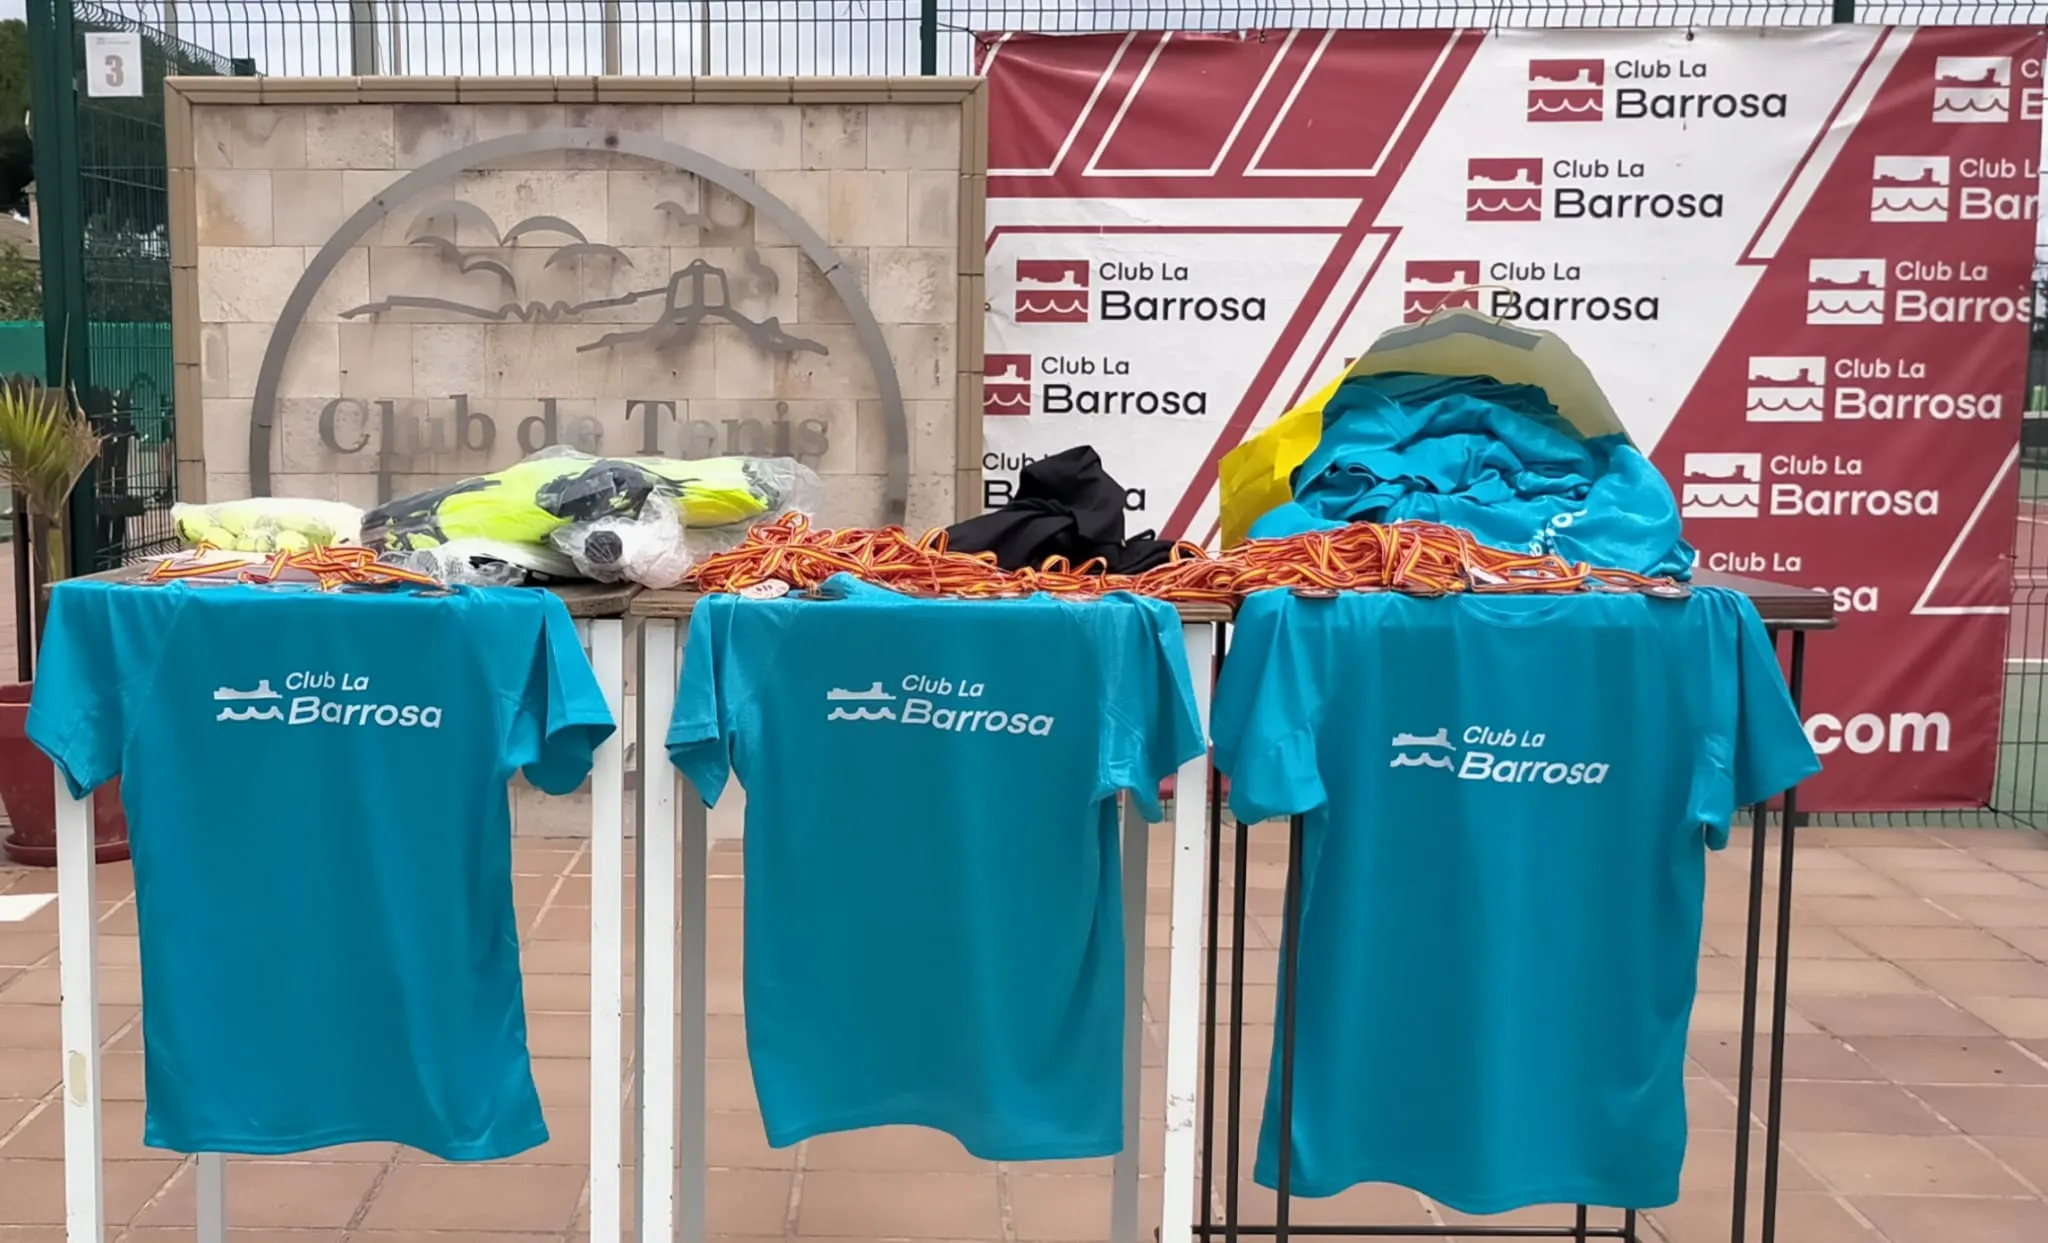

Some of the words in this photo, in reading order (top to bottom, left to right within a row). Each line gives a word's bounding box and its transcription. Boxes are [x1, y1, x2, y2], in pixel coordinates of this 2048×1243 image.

[105, 55, 124, 87] 3
[1615, 60, 1671, 78] Club
[1679, 60, 1707, 78] La
[1616, 89, 1787, 118] Barrosa
[1554, 160, 1609, 178] Club
[1617, 160, 1645, 178] La
[1960, 158, 2016, 178] Club
[1555, 189, 1723, 218] Barrosa
[1100, 262, 1153, 281] Club
[1162, 263, 1188, 281] La
[1491, 262, 1545, 281] Club
[1554, 263, 1580, 281] La
[1895, 261, 1952, 280] Club
[1960, 262, 1988, 280] La
[1101, 291, 1266, 321] Barrosa
[1491, 290, 1659, 321] Barrosa
[1042, 357, 1095, 375] Club
[1104, 358, 1129, 375] La
[1835, 359, 1891, 378] Club
[1898, 359, 1925, 378] La
[1043, 384, 1206, 414] Barrosa
[1835, 388, 2002, 419] Barrosa
[318, 394, 497, 456] Club
[517, 398, 604, 455] de
[625, 400, 830, 456] Tenis
[1771, 455, 1827, 475] Club
[1835, 456, 1862, 475] La
[1771, 484, 1939, 515] Barrosa
[1709, 552, 1766, 572] Club
[1773, 553, 1802, 572] La
[286, 671, 335, 690] Club
[341, 673, 369, 691] La
[902, 675, 952, 695] Club
[958, 679, 984, 697] La
[288, 697, 442, 728] Barrosa
[901, 698, 1054, 736] Barrosa
[1463, 726, 1516, 747] Club
[1521, 730, 1546, 748] La
[1458, 751, 1610, 785] Barrosa
